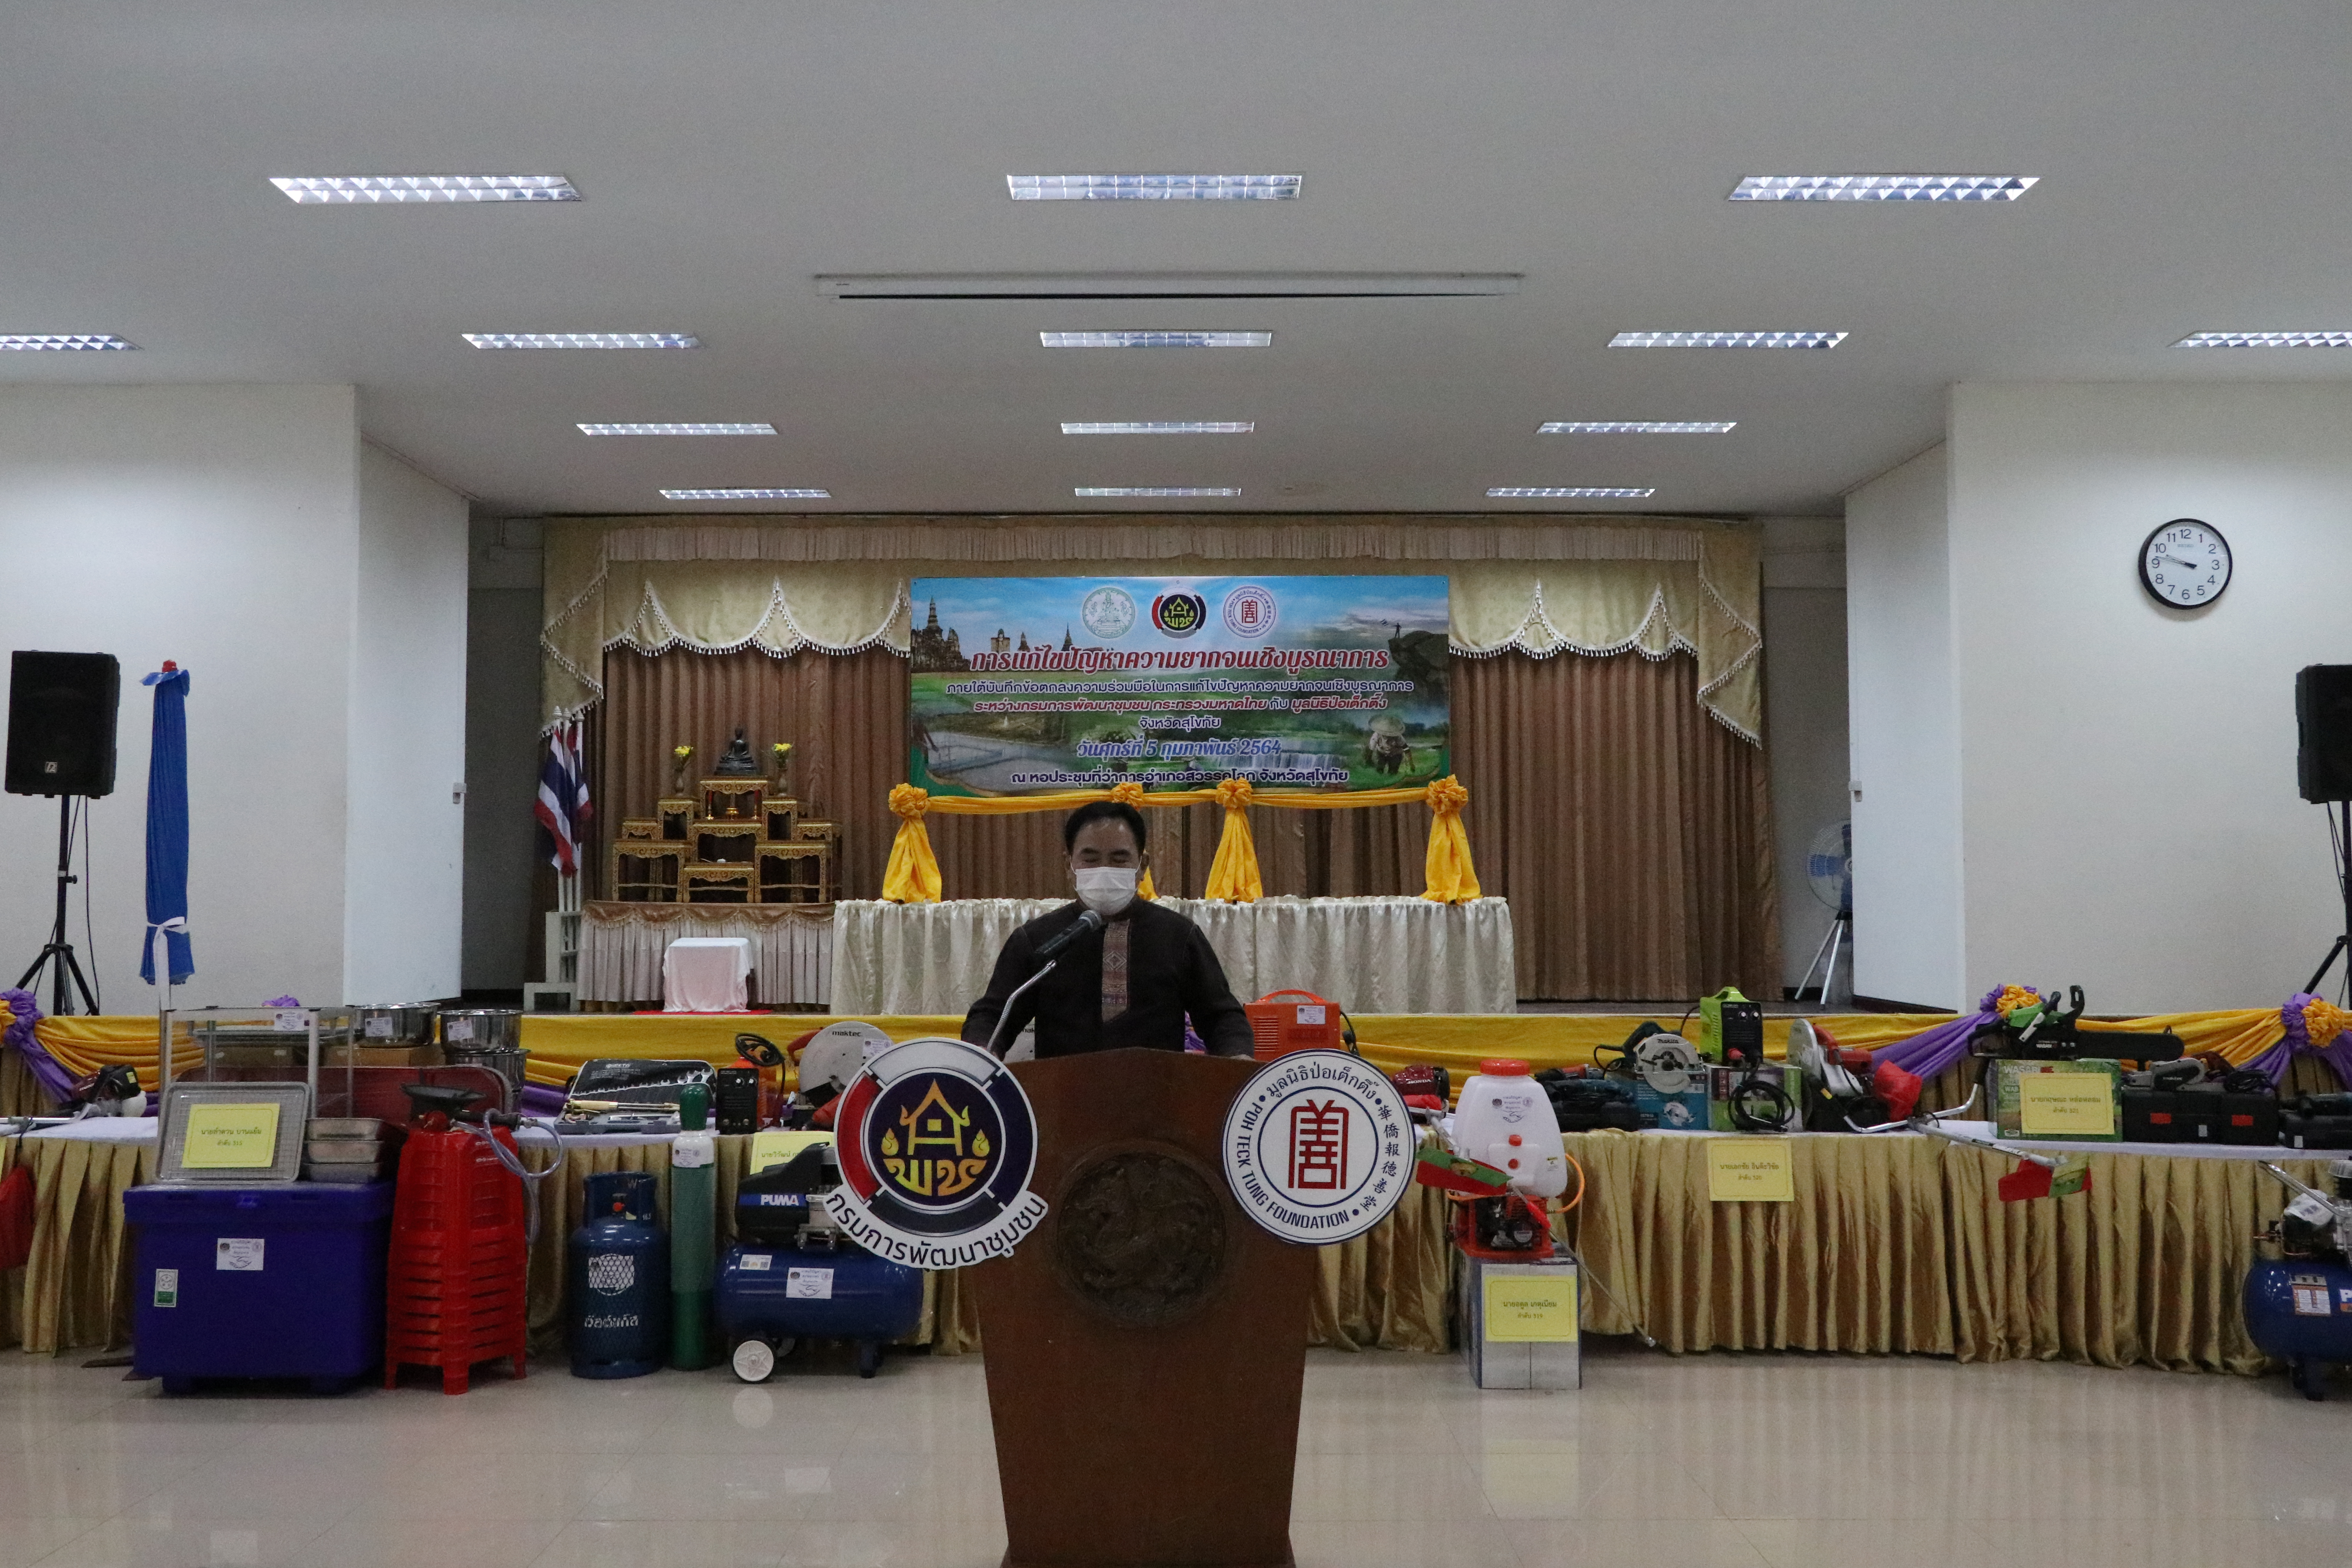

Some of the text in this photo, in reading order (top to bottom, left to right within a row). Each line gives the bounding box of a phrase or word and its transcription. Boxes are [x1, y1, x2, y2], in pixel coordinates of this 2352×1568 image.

[2167, 533, 2176, 542] 11
[2179, 529, 2191, 539] 12
[2198, 534, 2203, 543] 1
[2154, 543, 2166, 553] 10
[2209, 544, 2216, 554] 2
[2152, 558, 2160, 568] 9
[2212, 560, 2220, 570] 3
[2156, 573, 2163, 584] 8
[2207, 575, 2215, 585] 4
[2168, 585, 2175, 594] 7
[2182, 589, 2190, 599] 6
[2197, 585, 2205, 595] 5
[970, 645, 1389, 674] การแก้ไขปัญหาความยากจนเชิงบูรณาการ
[947, 679, 1414, 693] ภายใต้บันทึกข้อตกลงความร่วมมือในการแก้ไขปัญหาความยากจนเชิงบูรณาการ
[974, 699, 1150, 714] ระหว่างกรมการพัฒนาชุมชน
[1152, 696, 1268, 710] กระทรวงมหาดไทย
[1269, 697, 1288, 709] กับ
[1139, 716, 1221, 732] จังหวัดสุโขทัย
[1077, 734, 1281, 762] วันศุกร์ที่ 5 กุมภาพันธ์ 2564
[1012, 765, 1348, 788] ณ หอประชุมที่ว่าการอำเภอสวรรคโลก จังหวัดสุโขทัย
[1266, 1061, 1380, 1098] มูลนิธิป่อเต็กตึ๊ง
[1237, 1103, 1350, 1229] POH TECK TUNG FOUNDATION
[760, 1194, 799, 1206] PUMA
[826, 1193, 1046, 1266] กรมการพัฒนาชุมชน
